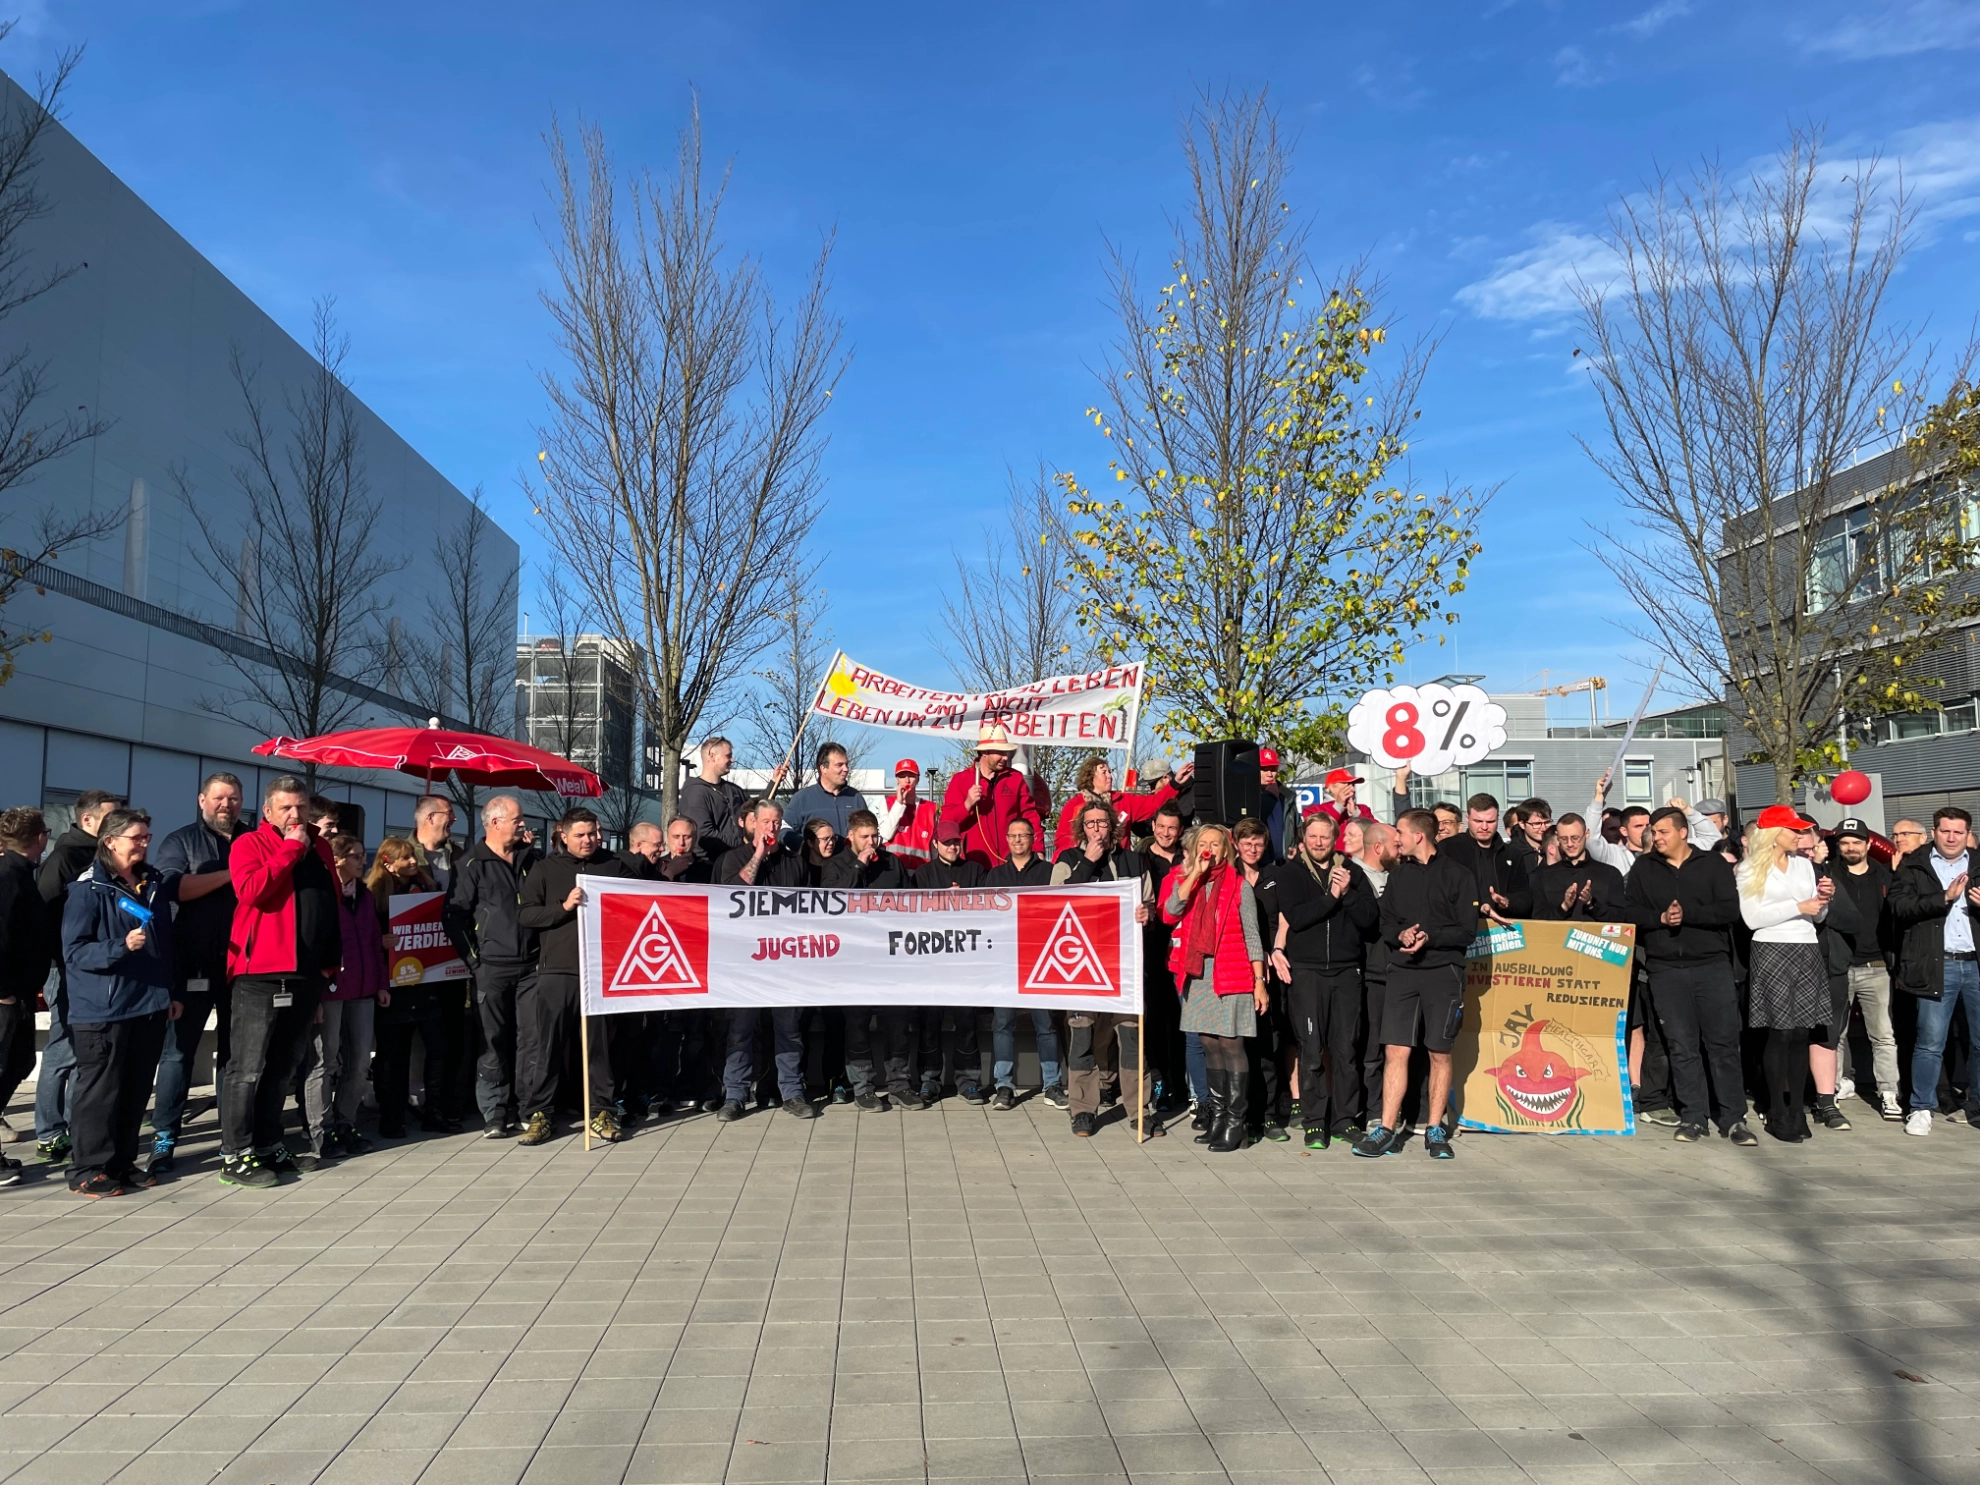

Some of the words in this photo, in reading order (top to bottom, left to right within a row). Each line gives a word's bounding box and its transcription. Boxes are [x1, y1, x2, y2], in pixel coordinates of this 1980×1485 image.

[850, 667, 964, 702] ARBEITEN
[1052, 666, 1139, 694] LEBEN
[815, 689, 893, 725] LEBEN
[895, 711, 926, 728] UM
[930, 714, 964, 731] ZU
[979, 711, 1117, 740] ARBEITEN
[924, 703, 967, 716] UND
[984, 696, 1050, 712] NICHT
[1296, 789, 1314, 814] P
[393, 925, 412, 935] WIR
[1570, 928, 1611, 949] ZUKUNFT
[1608, 941, 1628, 956] NUR
[751, 934, 841, 961] JUGEND
[1478, 943, 1495, 956] mit
[1496, 939, 1525, 952] allen.
[1566, 938, 1585, 952] MIT
[1583, 944, 1604, 960] UNS.
[1471, 961, 1488, 972] IN
[1494, 962, 1574, 976] AUSBILDUNG
[1467, 974, 1552, 989] NVESTIEREN
[1556, 978, 1601, 990] STATT
[1499, 1003, 1535, 1048] JAV
[1546, 1022, 1603, 1077] HEALTHCARE
